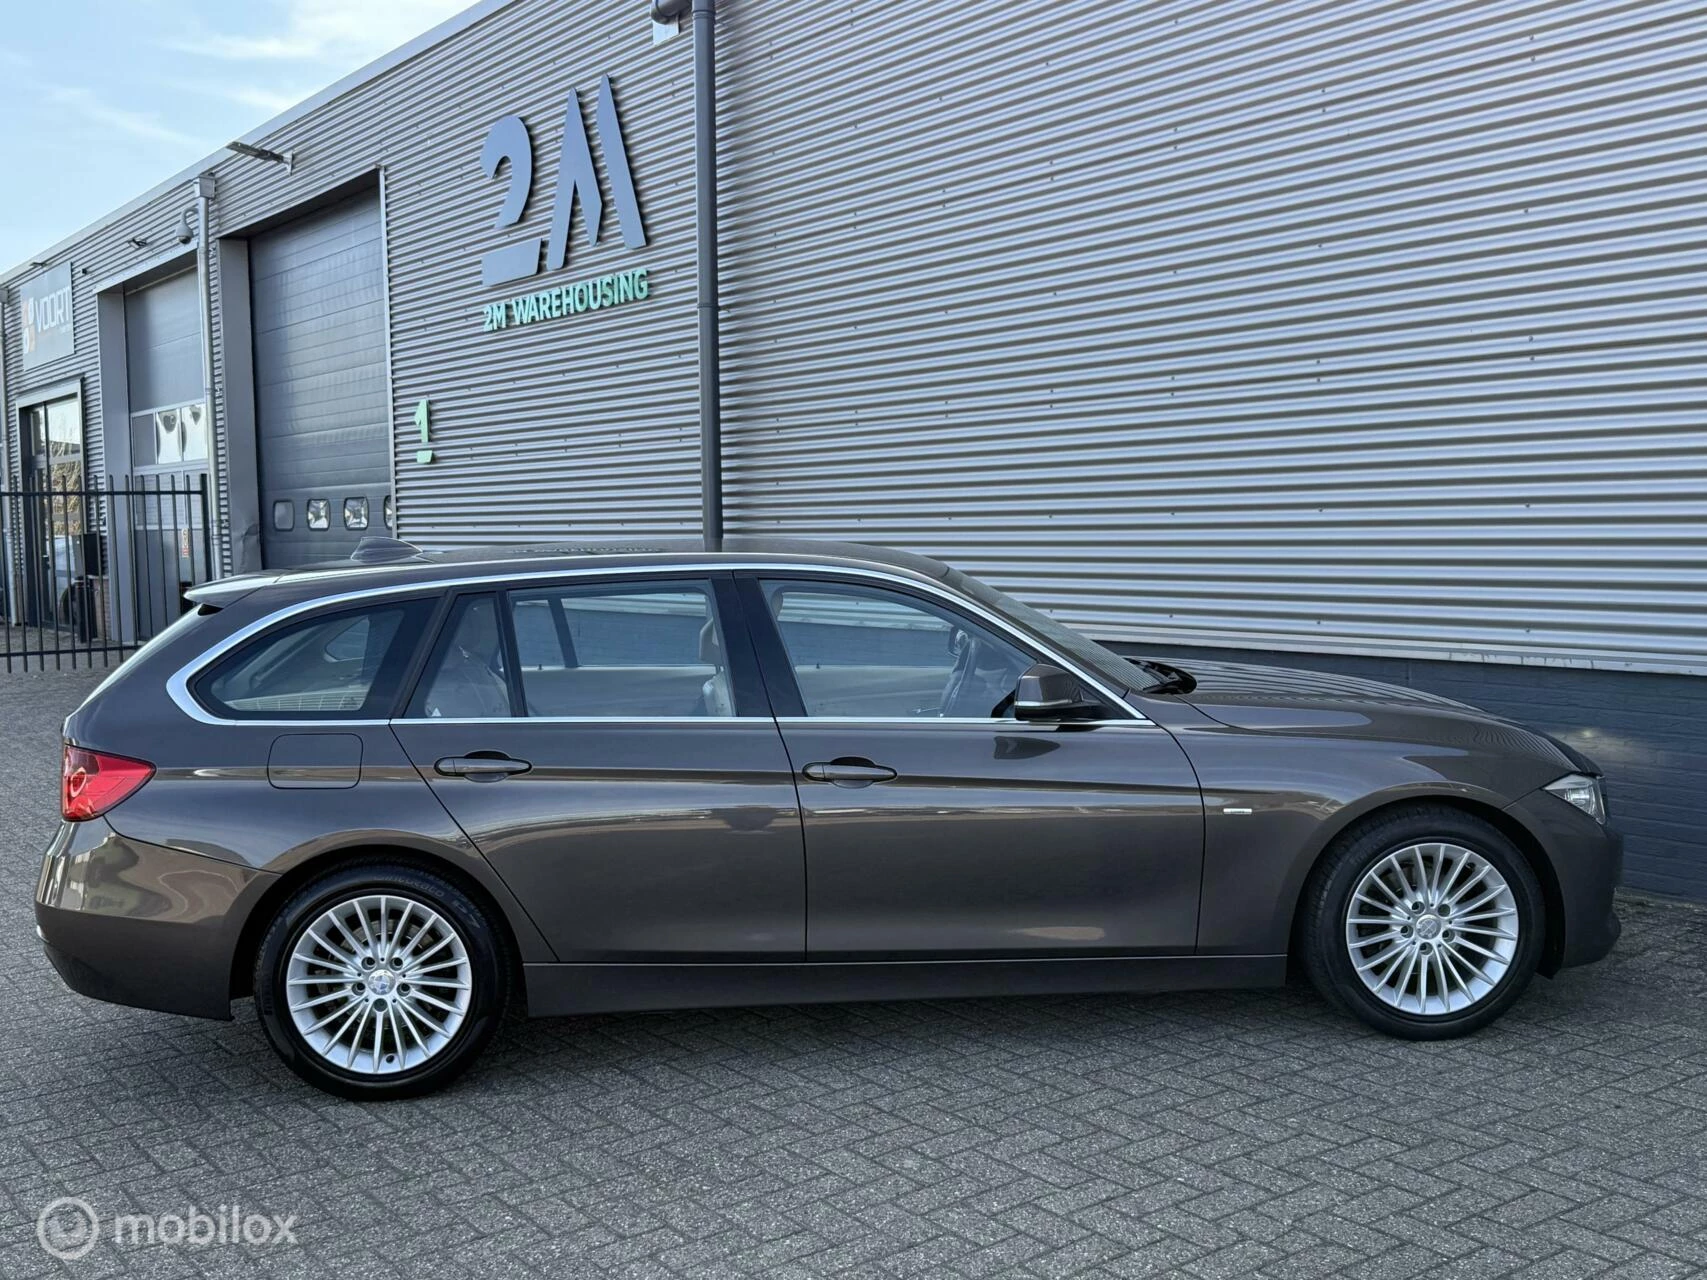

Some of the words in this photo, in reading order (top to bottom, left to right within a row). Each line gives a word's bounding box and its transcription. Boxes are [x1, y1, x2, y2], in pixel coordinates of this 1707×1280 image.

[480, 73, 647, 287] 2M
[483, 303, 507, 332] 2M
[511, 267, 649, 326] WAREHOUSING
